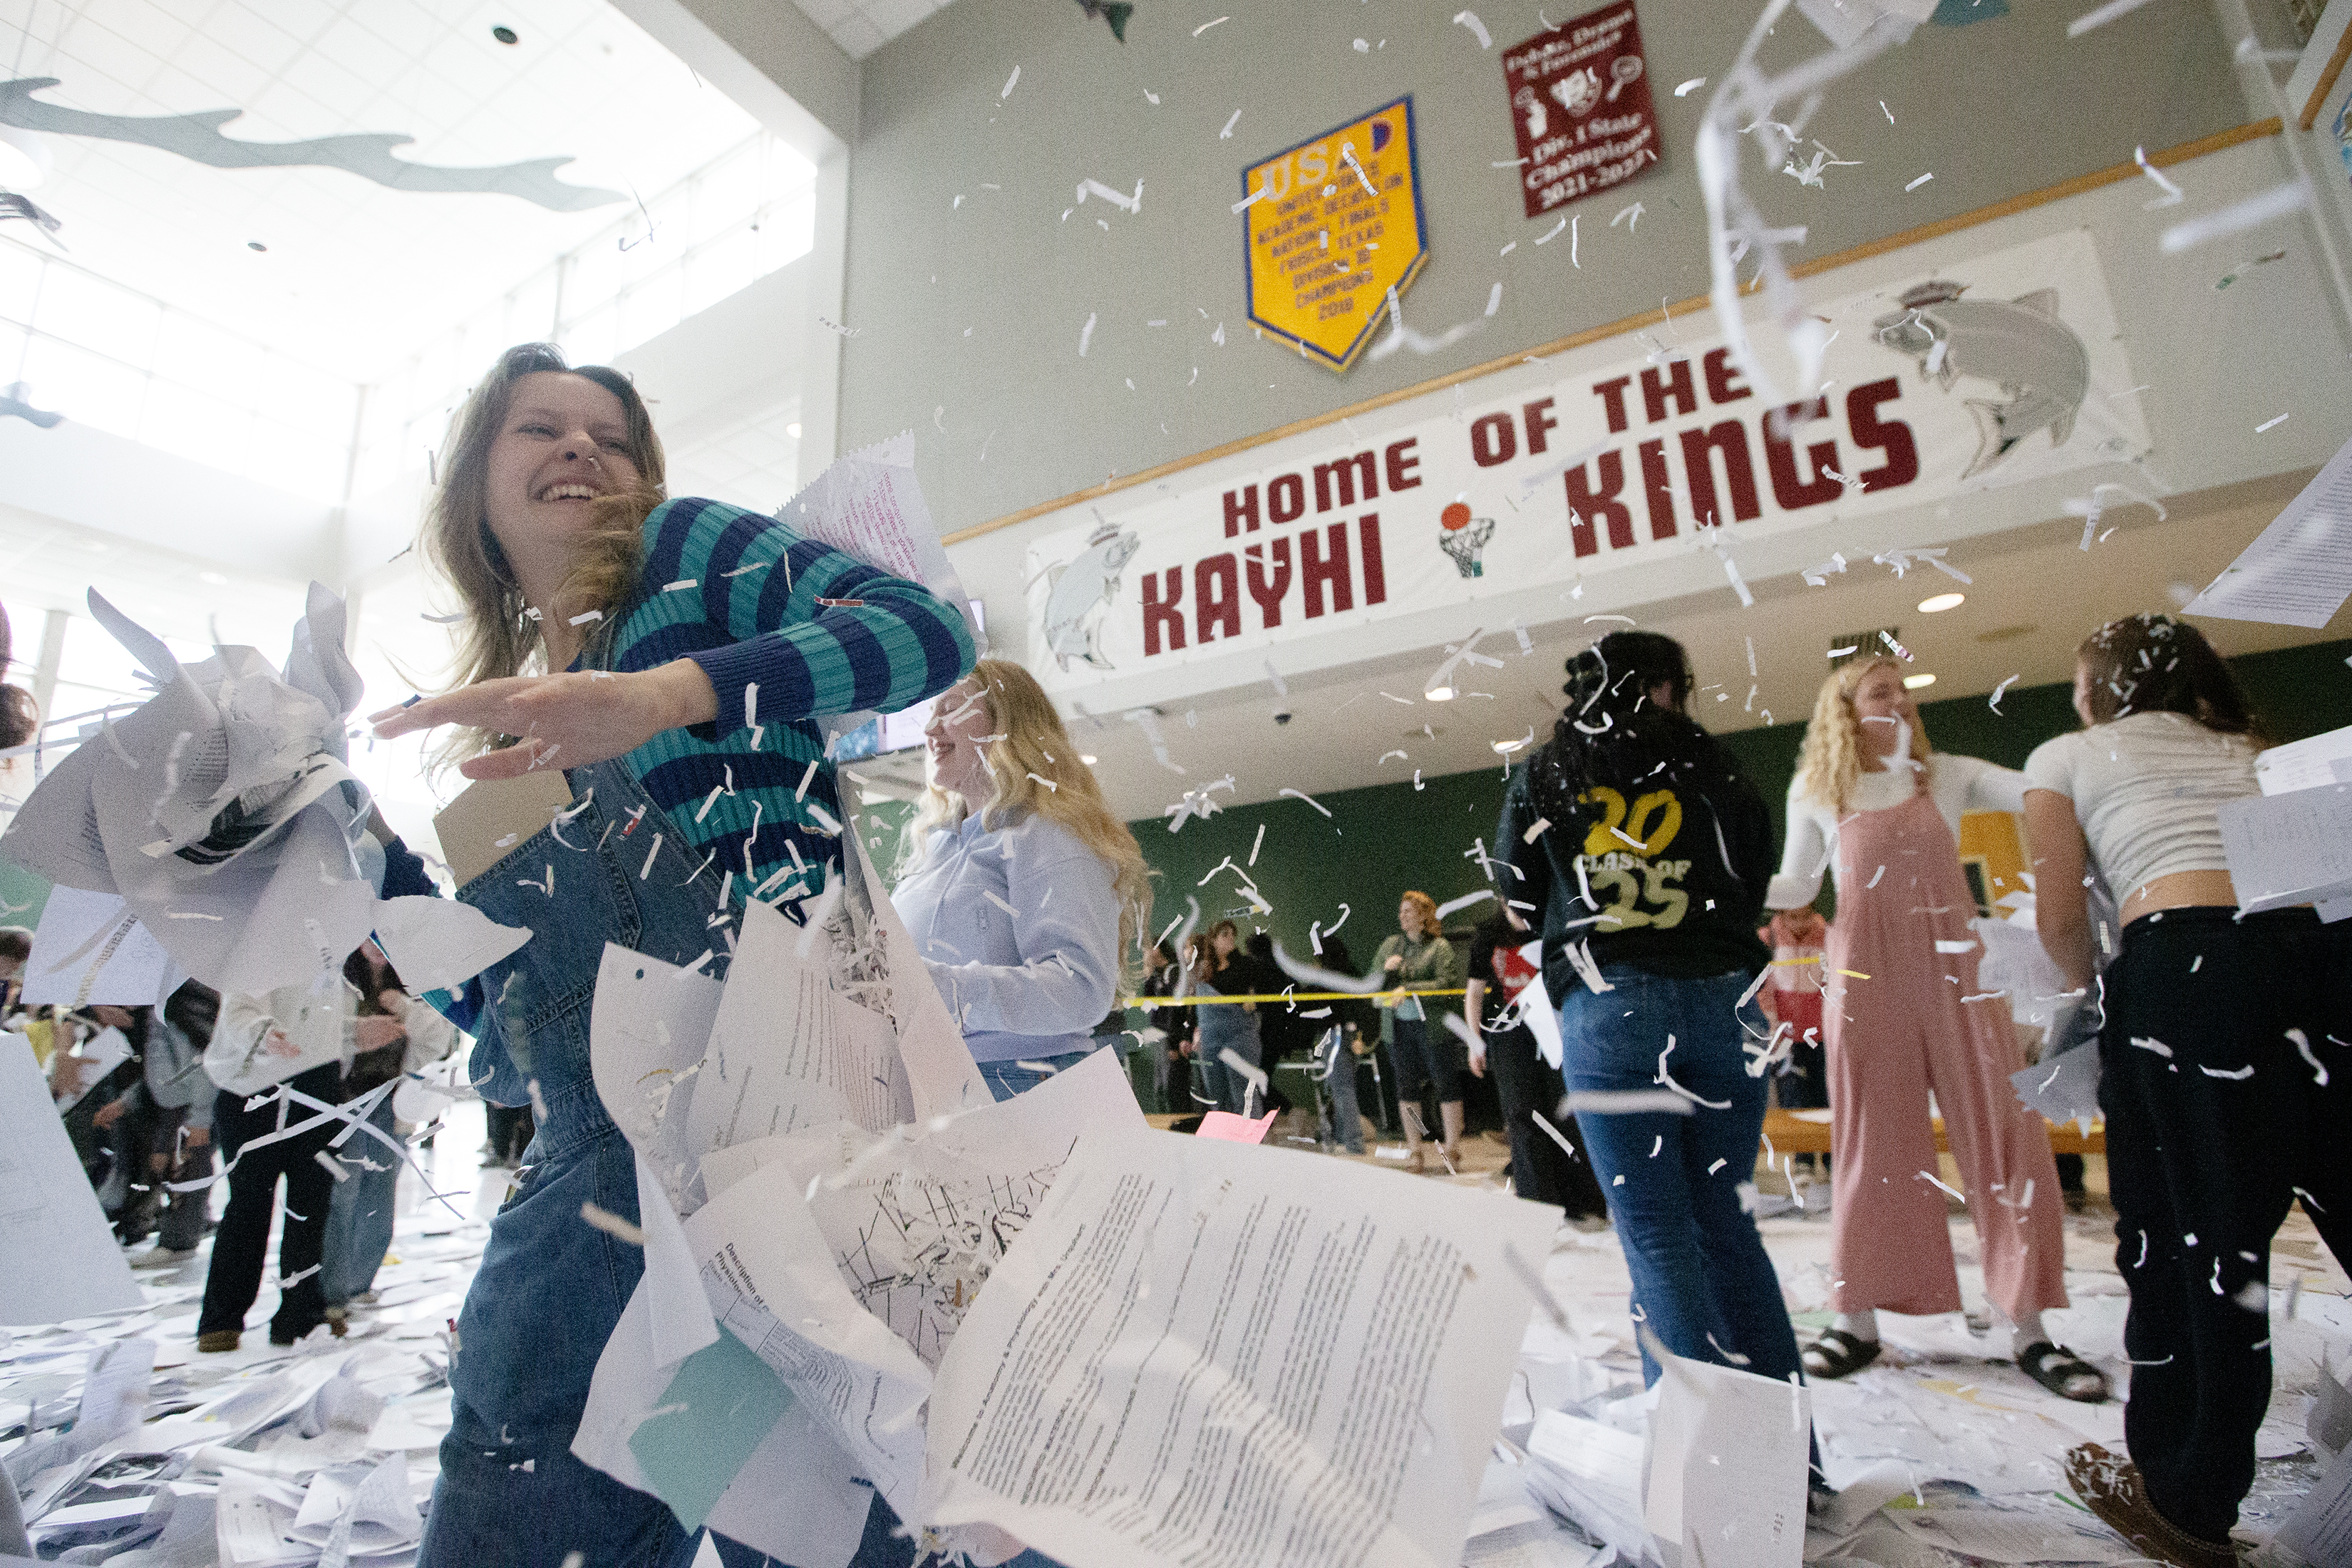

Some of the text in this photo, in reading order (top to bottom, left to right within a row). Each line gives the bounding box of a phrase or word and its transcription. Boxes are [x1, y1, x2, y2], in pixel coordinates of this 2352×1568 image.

[1526, 125, 1651, 189] Champions
[1589, 113, 1641, 138] State
[1223, 347, 1752, 538] HOME OF THE
[1142, 376, 1919, 658] KAYHI KINGS
[1578, 786, 1682, 859] 20
[1589, 870, 1688, 933] 25
[1656, 860, 1691, 882] OF
[724, 1242, 758, 1295] Description
